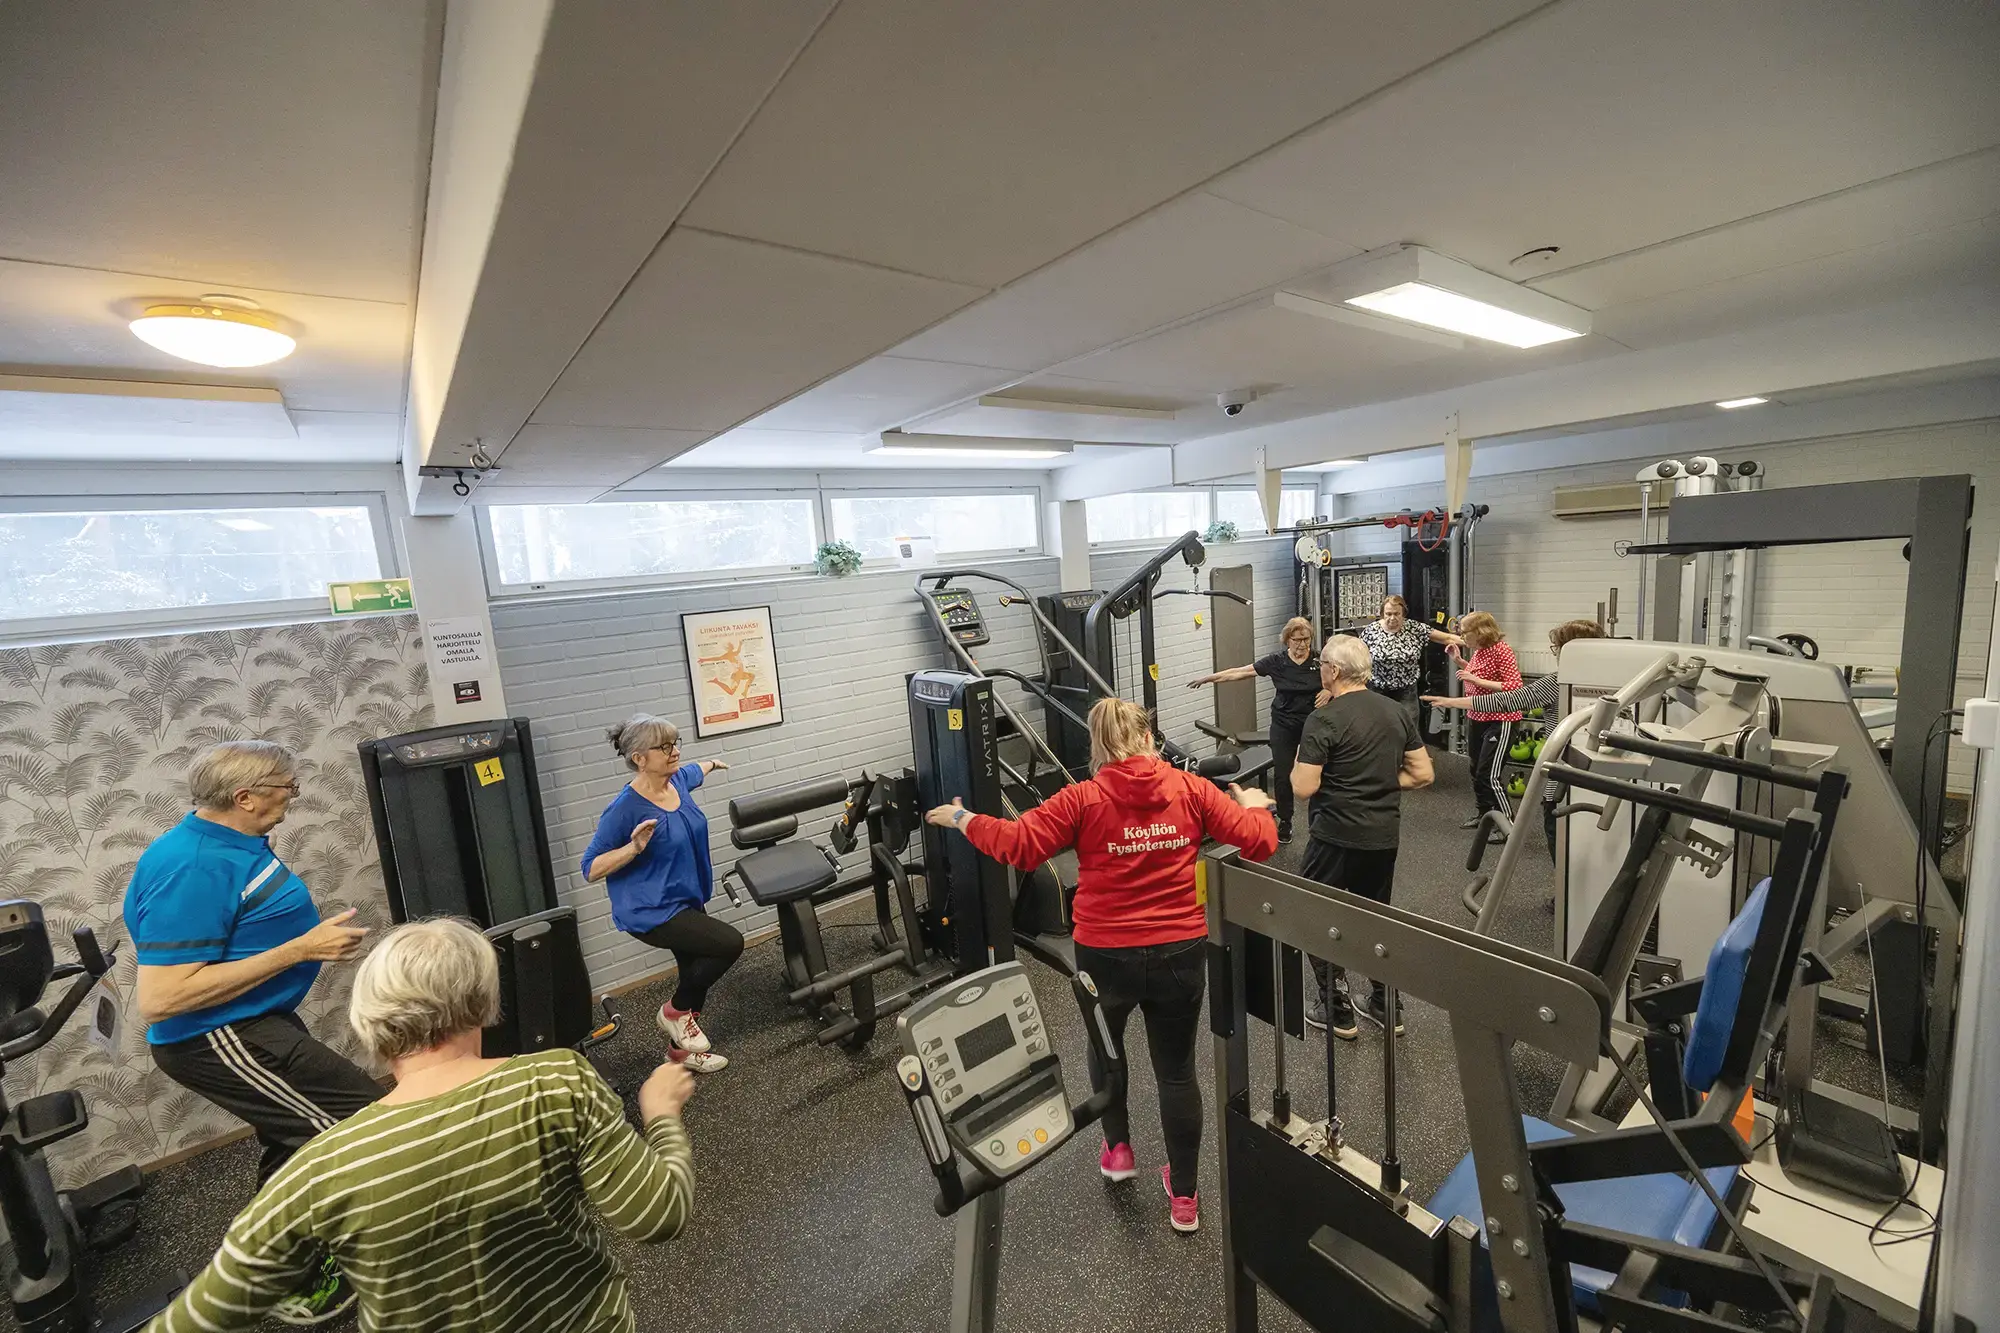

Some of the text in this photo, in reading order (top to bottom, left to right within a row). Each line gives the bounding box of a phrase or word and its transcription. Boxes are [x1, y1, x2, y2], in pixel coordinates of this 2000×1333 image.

[700, 626, 731, 634] LIIKUNTA
[433, 632, 482, 641] KUNTOSALILLA
[437, 640, 480, 649] HARJOITTELU
[446, 648, 474, 656] OMALLA
[441, 655, 481, 664] VASTUULLA.
[952, 713, 962, 727] 5.
[979, 702, 994, 777] MATRIX
[483, 764, 500, 779] 4.
[1123, 823, 1177, 839] Köyliön
[1107, 835, 1190, 855] Fysioterapia
